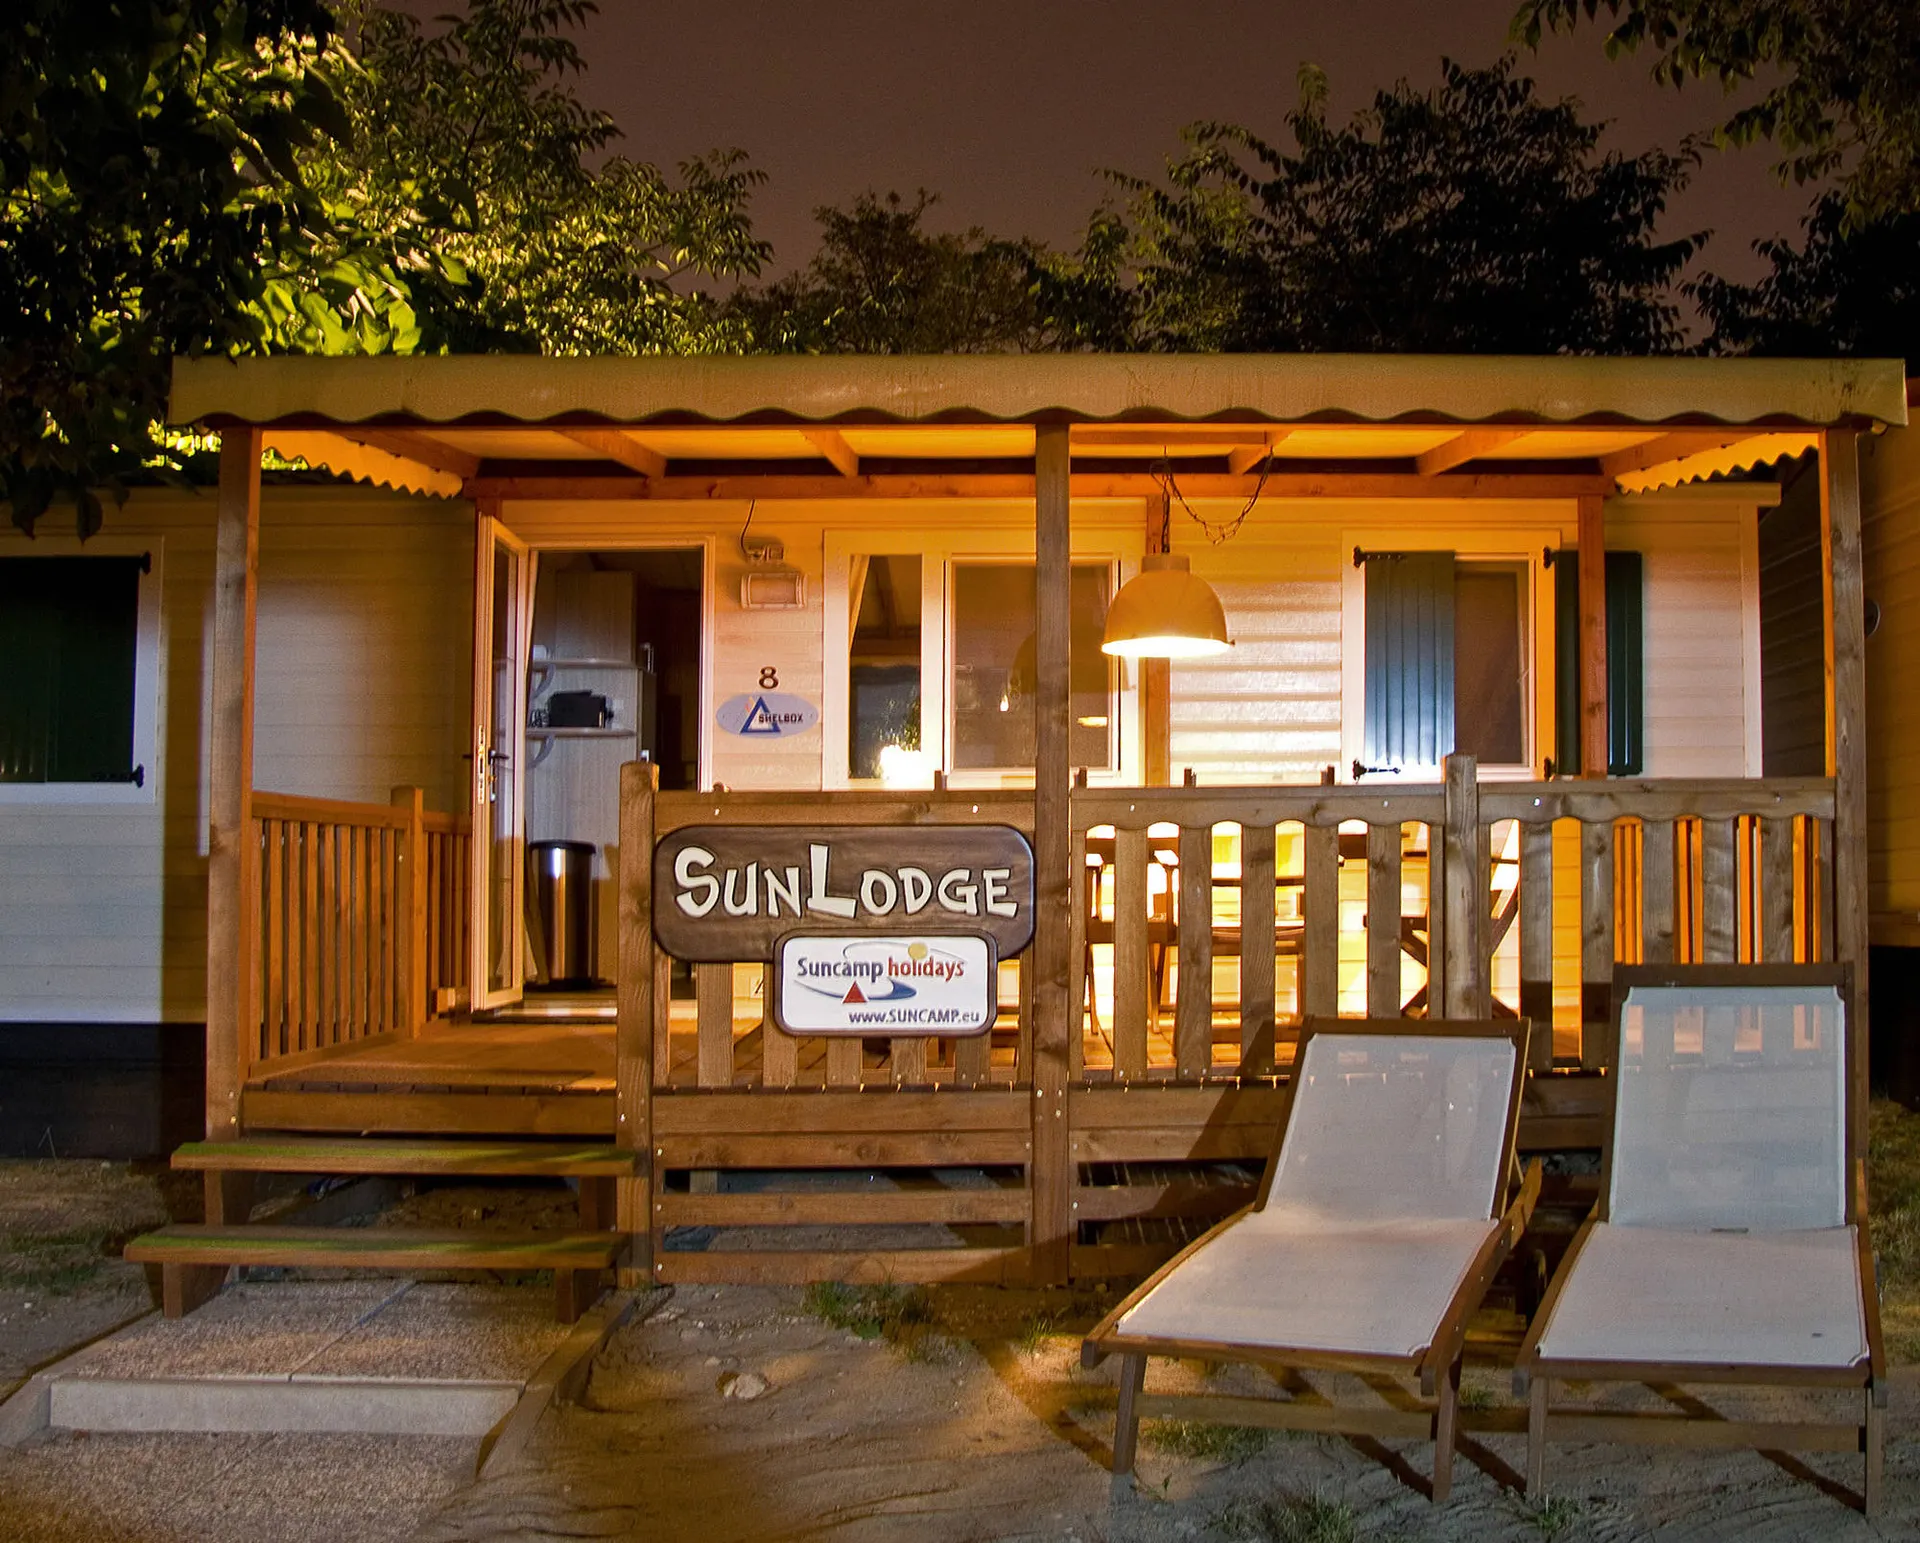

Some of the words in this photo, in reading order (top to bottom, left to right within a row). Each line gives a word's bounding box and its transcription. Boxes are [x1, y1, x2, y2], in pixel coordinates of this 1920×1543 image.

[758, 666, 779, 690] 8
[758, 713, 804, 724] SHELBOX
[797, 956, 884, 984] Suncamp
[888, 955, 965, 983] holidays
[848, 1008, 980, 1024] www.SUNCAMP.eu
